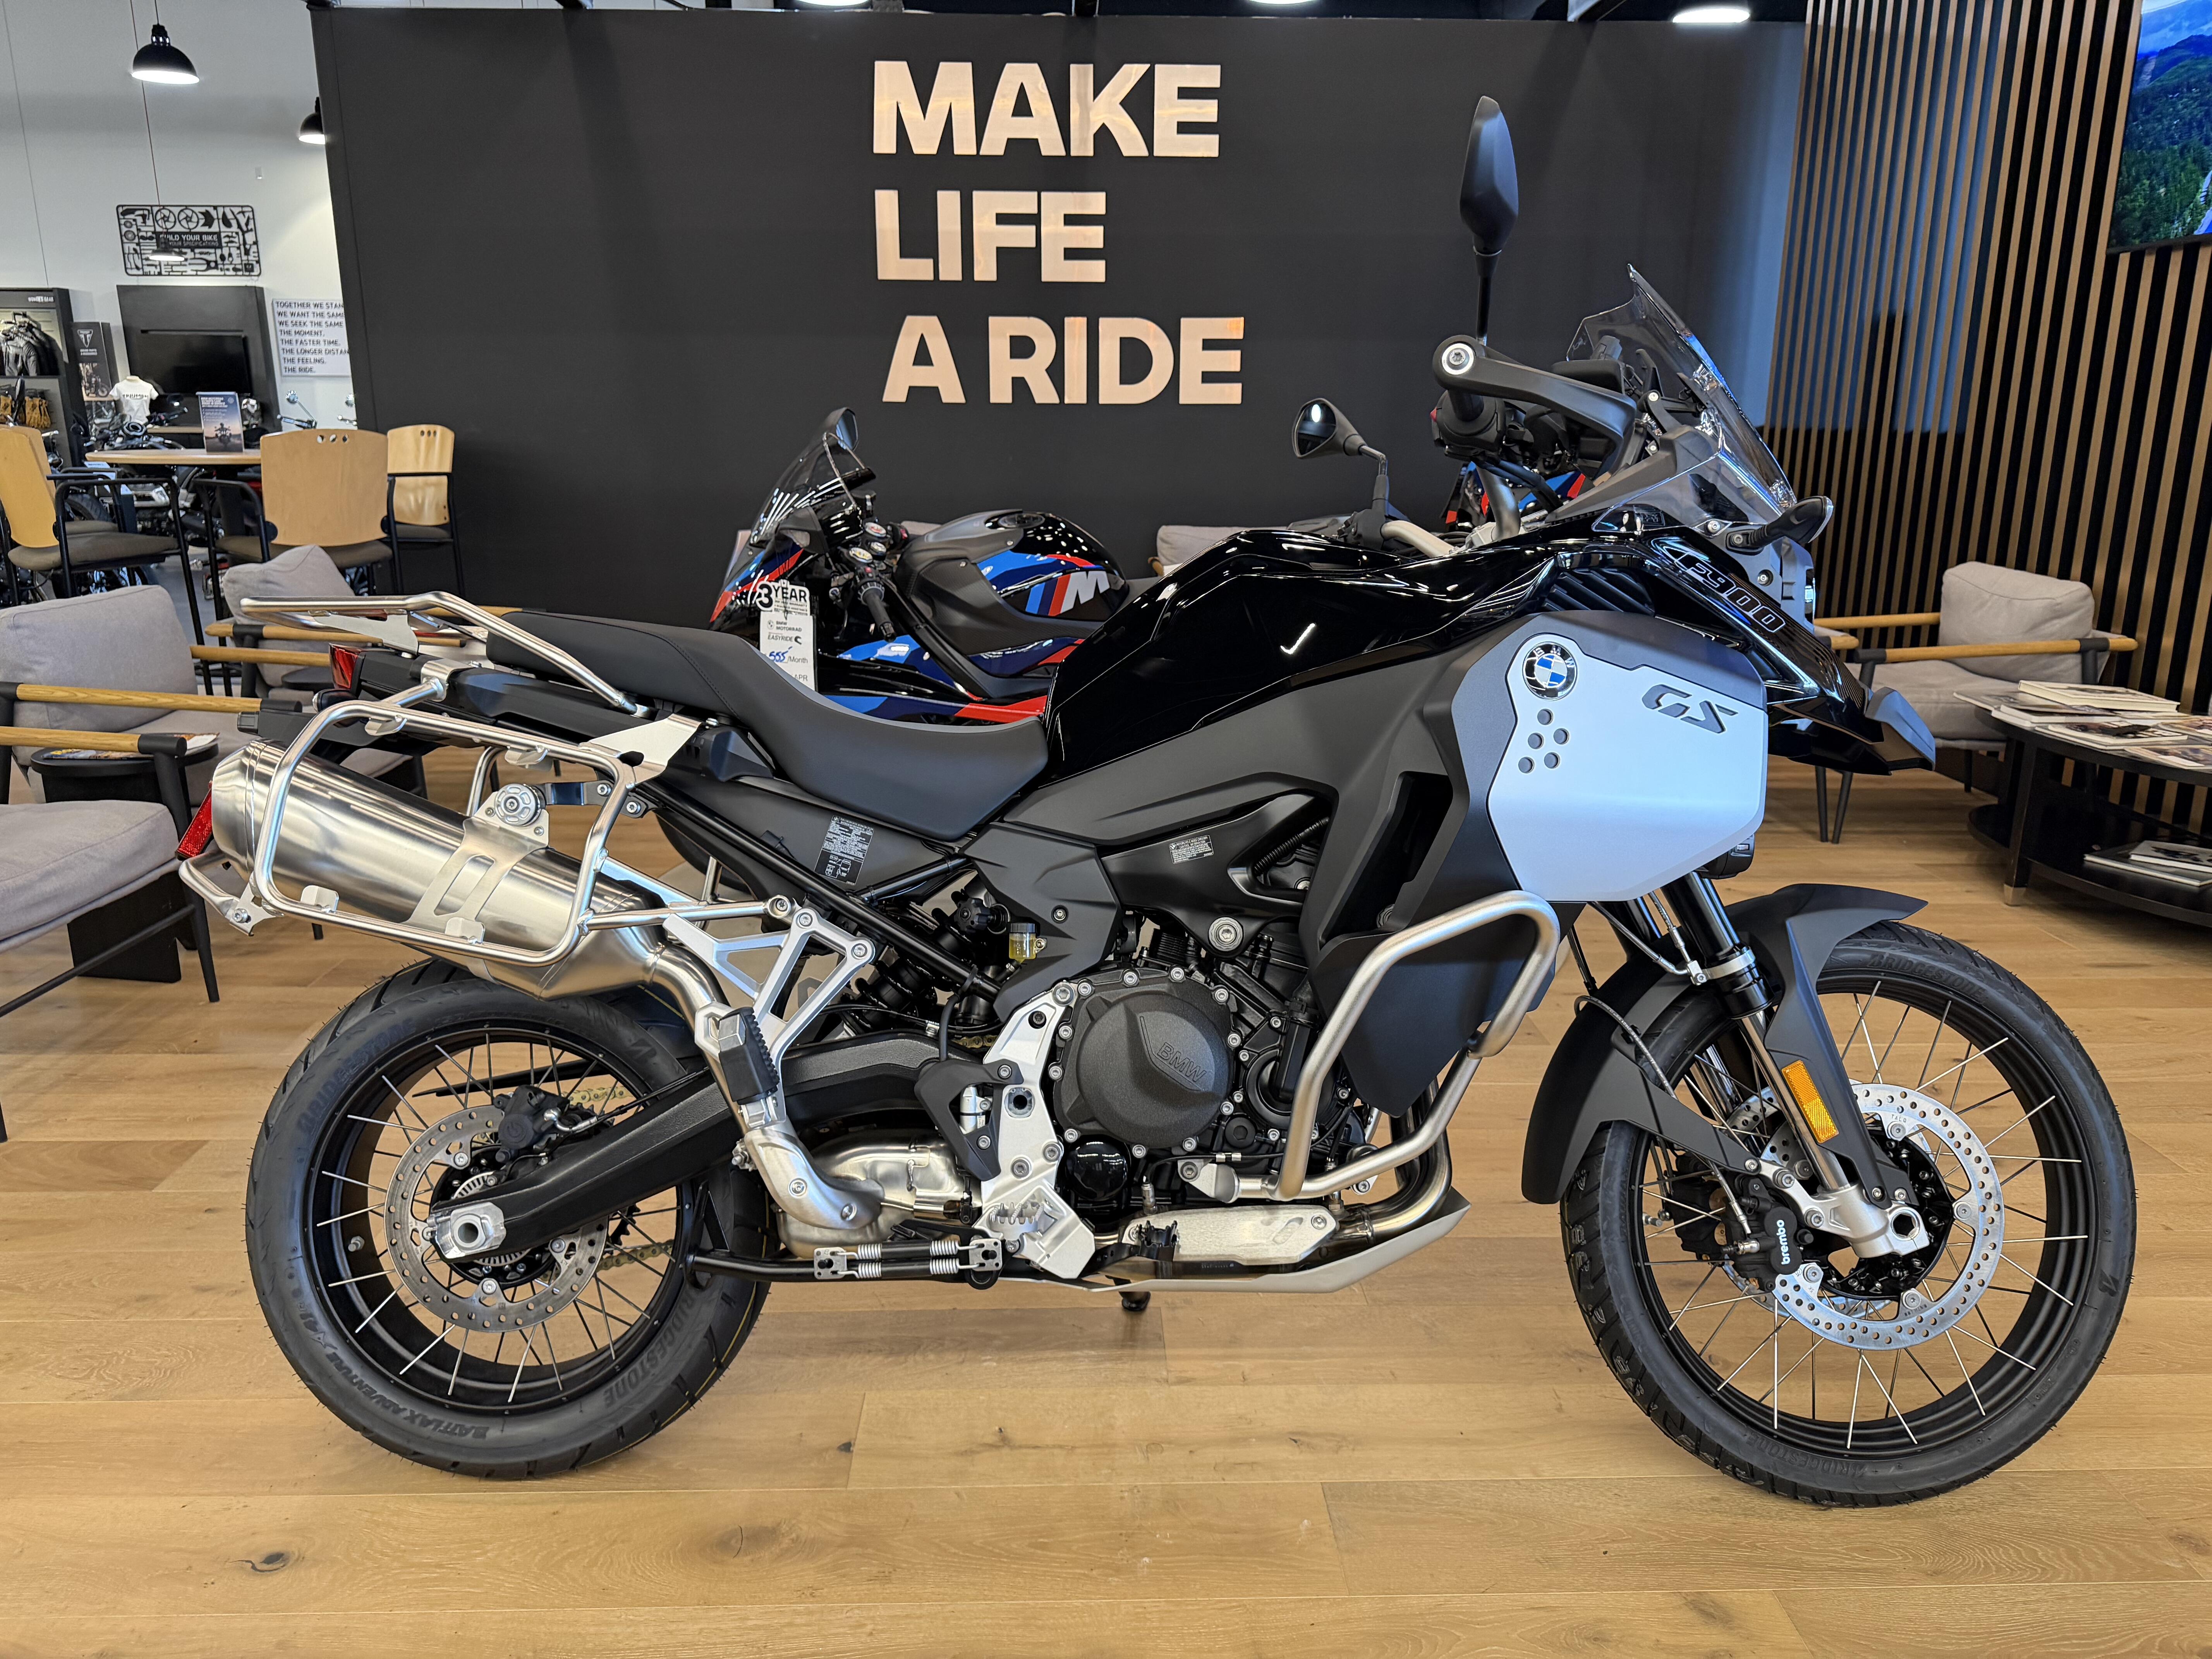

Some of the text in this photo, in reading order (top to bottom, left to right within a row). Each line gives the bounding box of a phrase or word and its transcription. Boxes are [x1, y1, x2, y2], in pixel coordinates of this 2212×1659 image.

[873, 61, 1221, 157] MAKE
[874, 189, 1106, 282] LIFE
[882, 315, 1244, 404] A RIDE
[759, 584, 807, 608] 3 YEAR
[1674, 552, 1786, 632] F900
[768, 634, 793, 642] EASYRIDE
[1533, 644, 1575, 668] BMW
[1642, 684, 1738, 733] GS
[1157, 1042, 1207, 1082] BMW
[1776, 1219, 1791, 1265] brembo
[326, 1352, 407, 1414] ADVENTURE
[404, 1409, 489, 1439] BATTLAX
